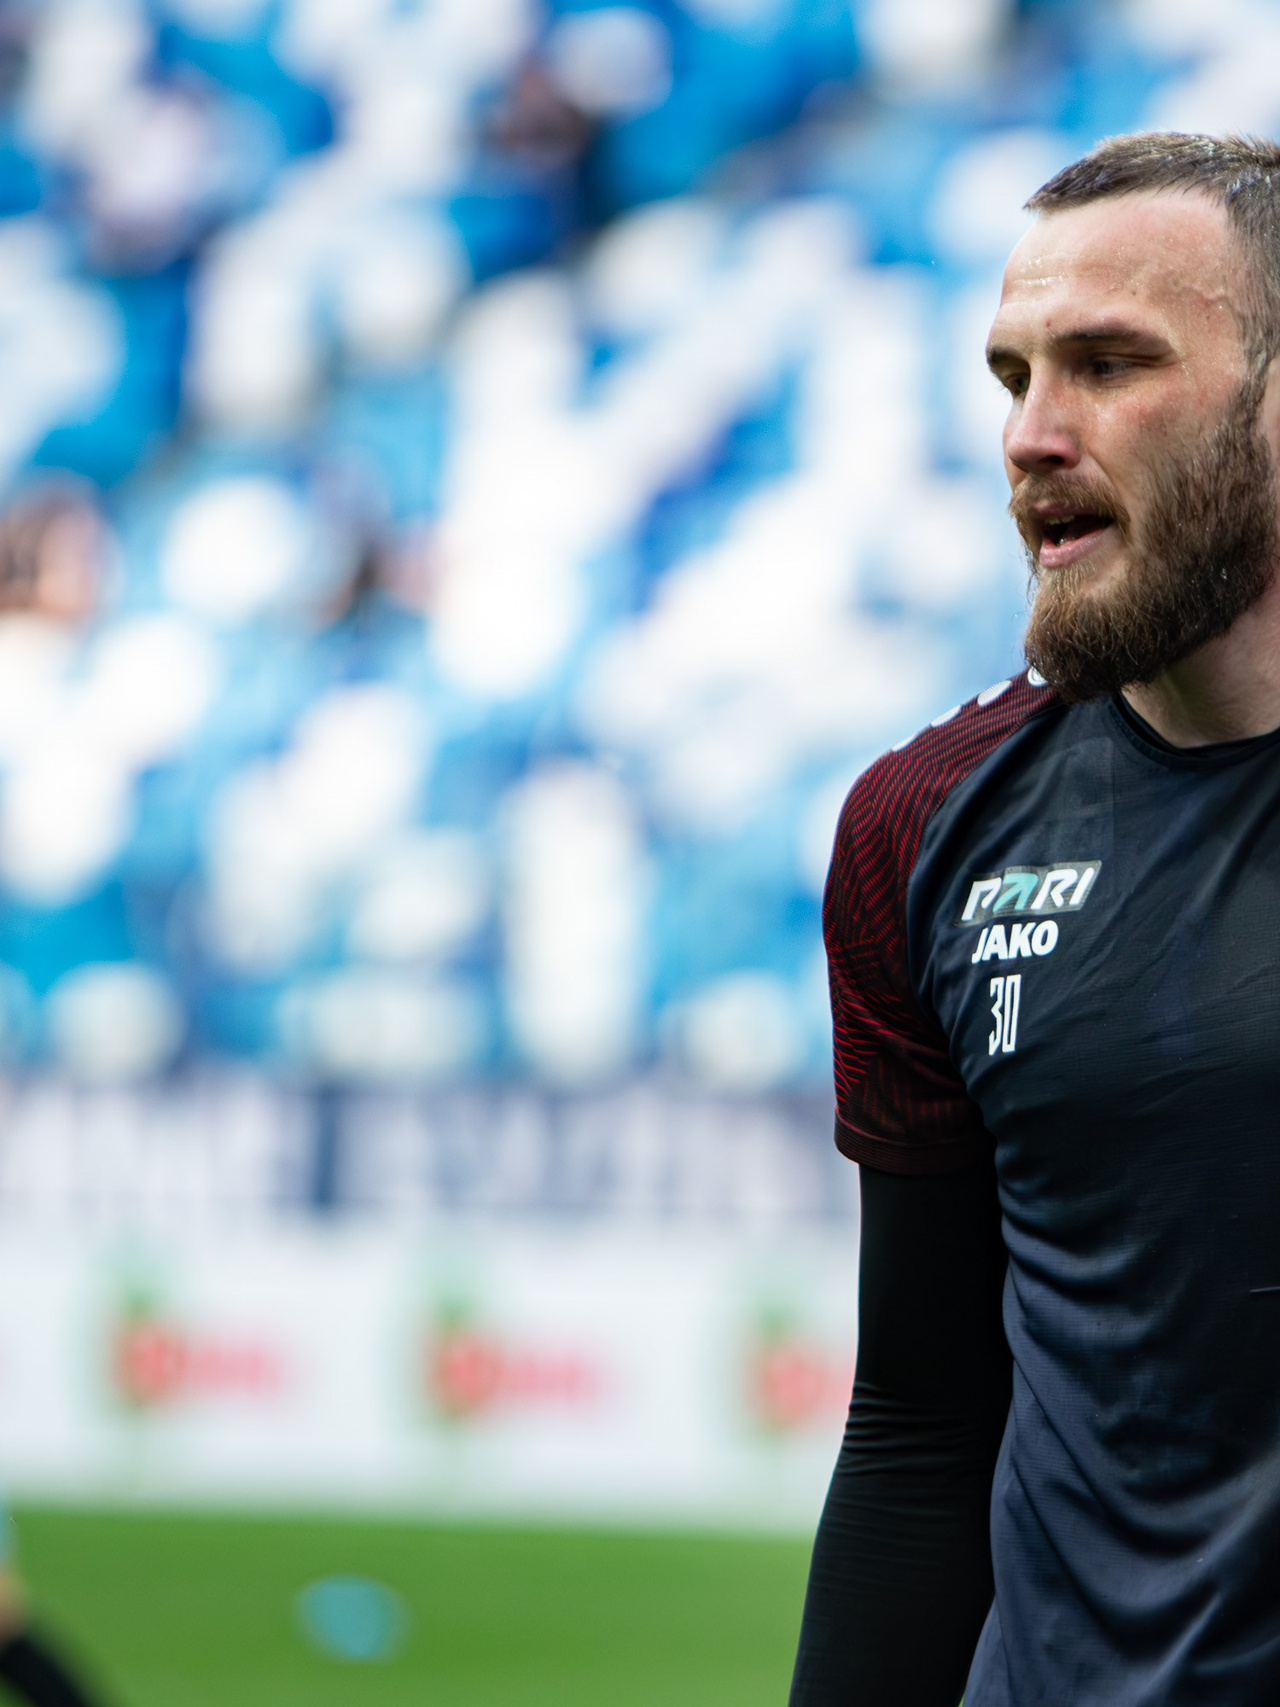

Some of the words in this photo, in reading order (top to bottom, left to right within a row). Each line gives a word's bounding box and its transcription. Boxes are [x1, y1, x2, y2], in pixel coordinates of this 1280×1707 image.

[961, 867, 1094, 921] PARI
[971, 920, 1059, 964] JAKO
[989, 974, 1021, 1056] 30
